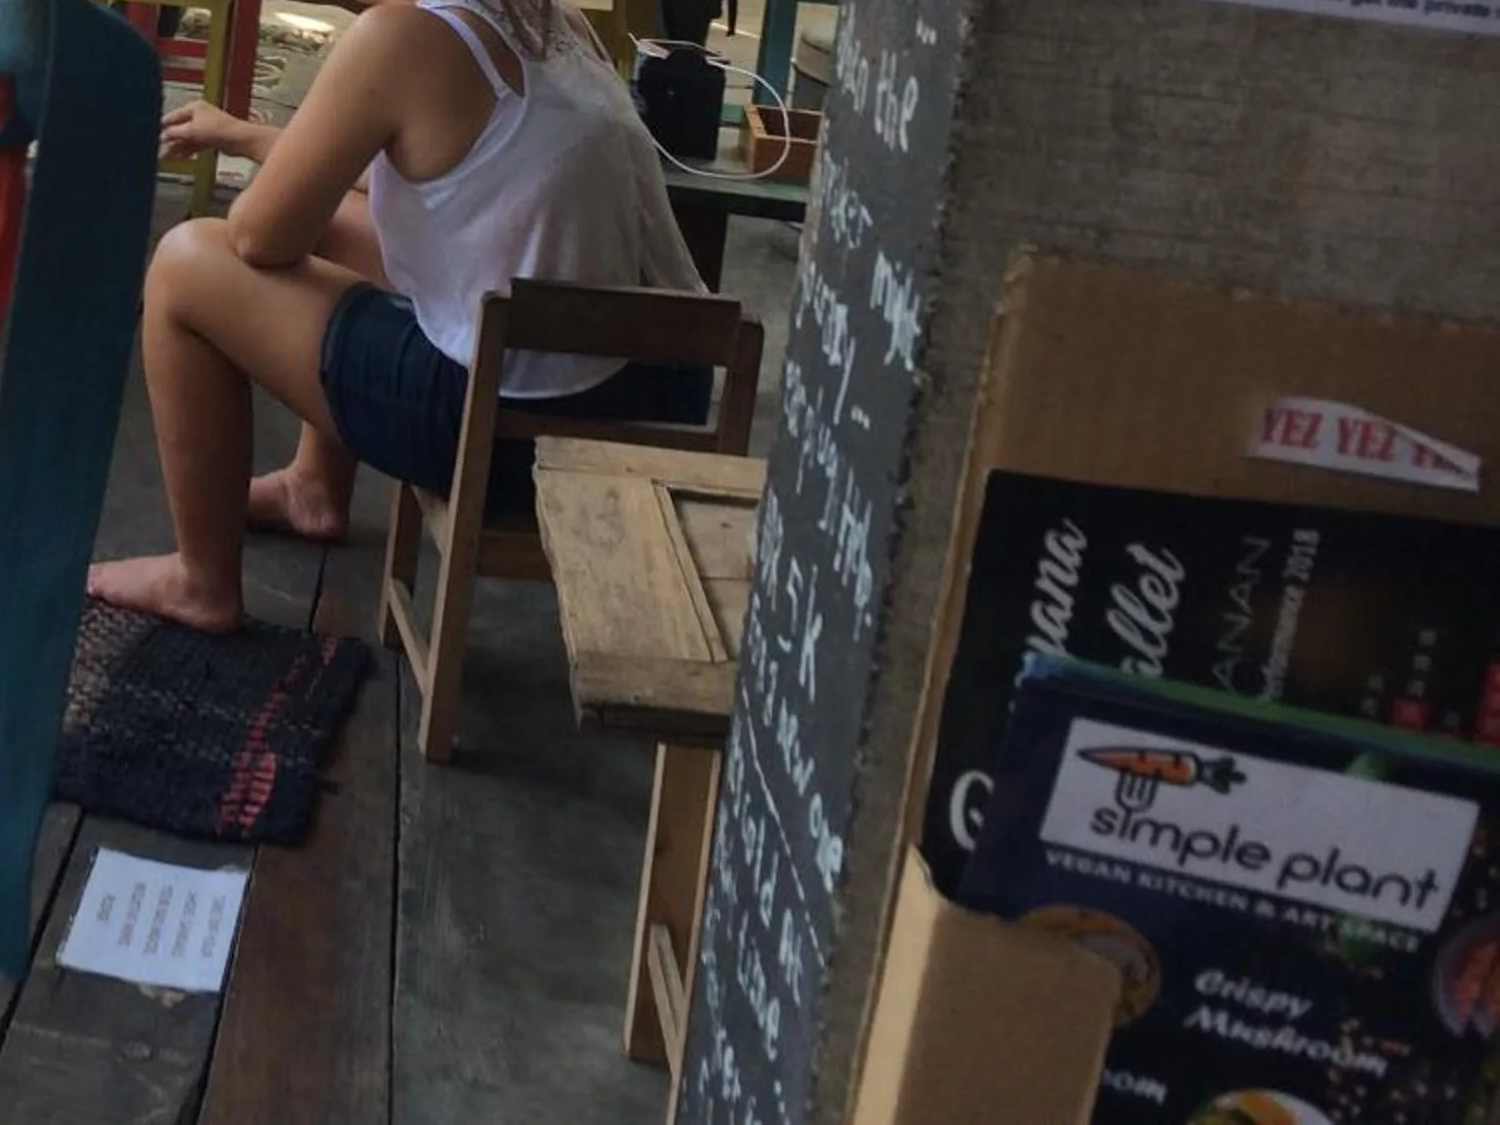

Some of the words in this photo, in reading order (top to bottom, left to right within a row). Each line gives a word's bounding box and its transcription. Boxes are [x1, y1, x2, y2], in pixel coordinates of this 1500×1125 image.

[1423, 0, 1491, 19] private
[1261, 407, 1324, 450] YEZ
[1336, 415, 1400, 463] YEZ
[1089, 800, 1272, 870] simple
[1276, 847, 1441, 911] plant
[1044, 848, 1132, 886] VEGAN
[1136, 867, 1250, 911] KITCHEN
[1281, 904, 1333, 932] ART
[1194, 968, 1314, 1018] Crispy
